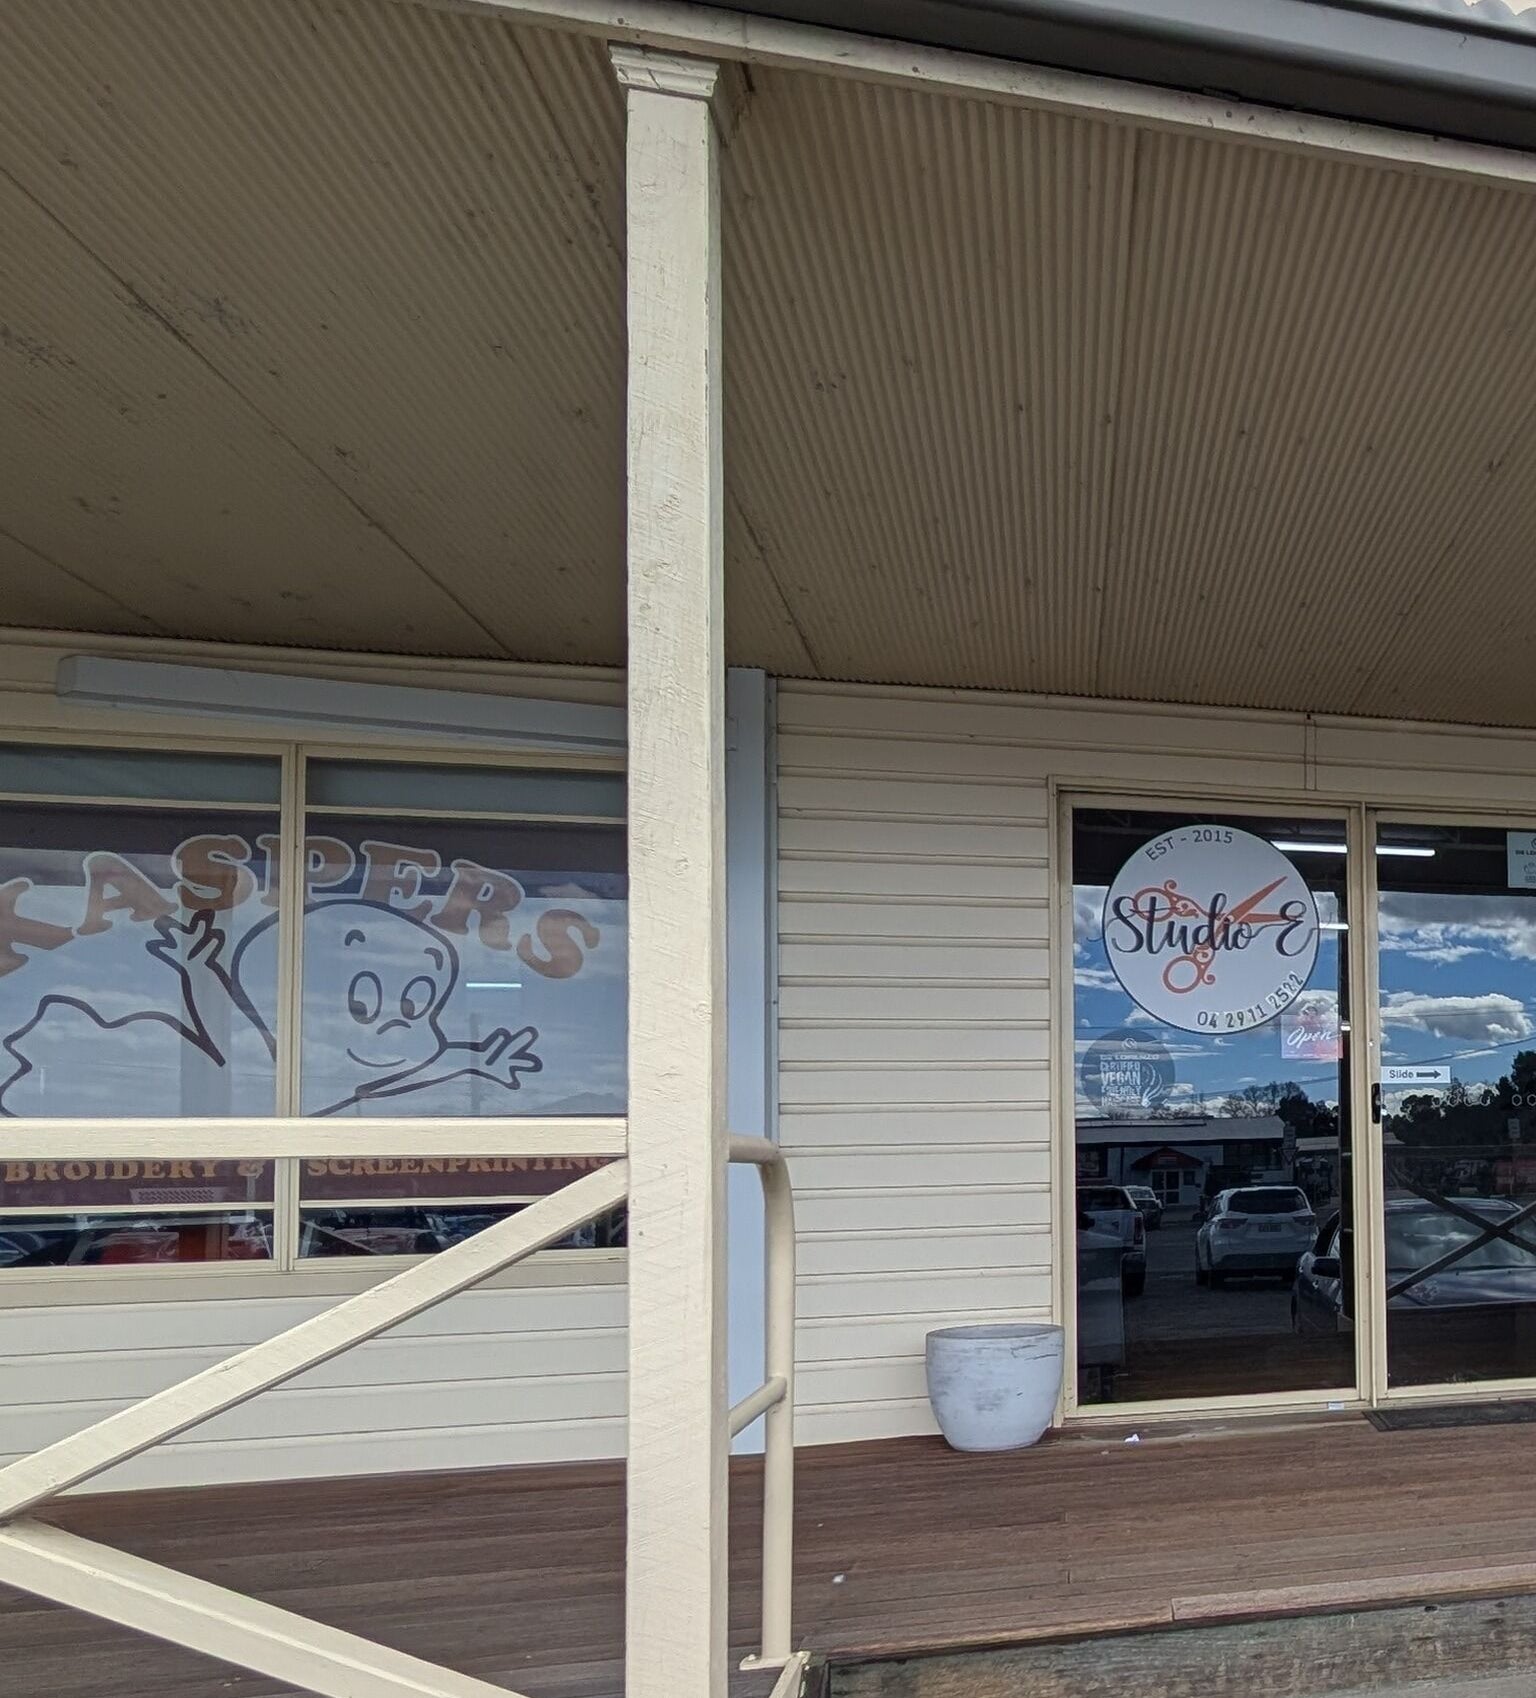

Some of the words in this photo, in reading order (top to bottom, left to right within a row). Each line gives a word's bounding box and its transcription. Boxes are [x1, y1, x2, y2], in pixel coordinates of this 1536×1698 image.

[1145, 836, 1176, 861] EST
[1192, 829, 1234, 844] 2015
[0, 834, 600, 979] KASPERS
[1106, 892, 1258, 955] Studio
[1275, 900, 1315, 957] E
[1197, 1010, 1218, 1028] 04
[1226, 1004, 1267, 1028] 2911
[1268, 973, 1304, 1010] 2522
[1286, 1025, 1340, 1048] Open
[1100, 1071, 1141, 1087] VEGAN
[1389, 1069, 1414, 1079] Slide
